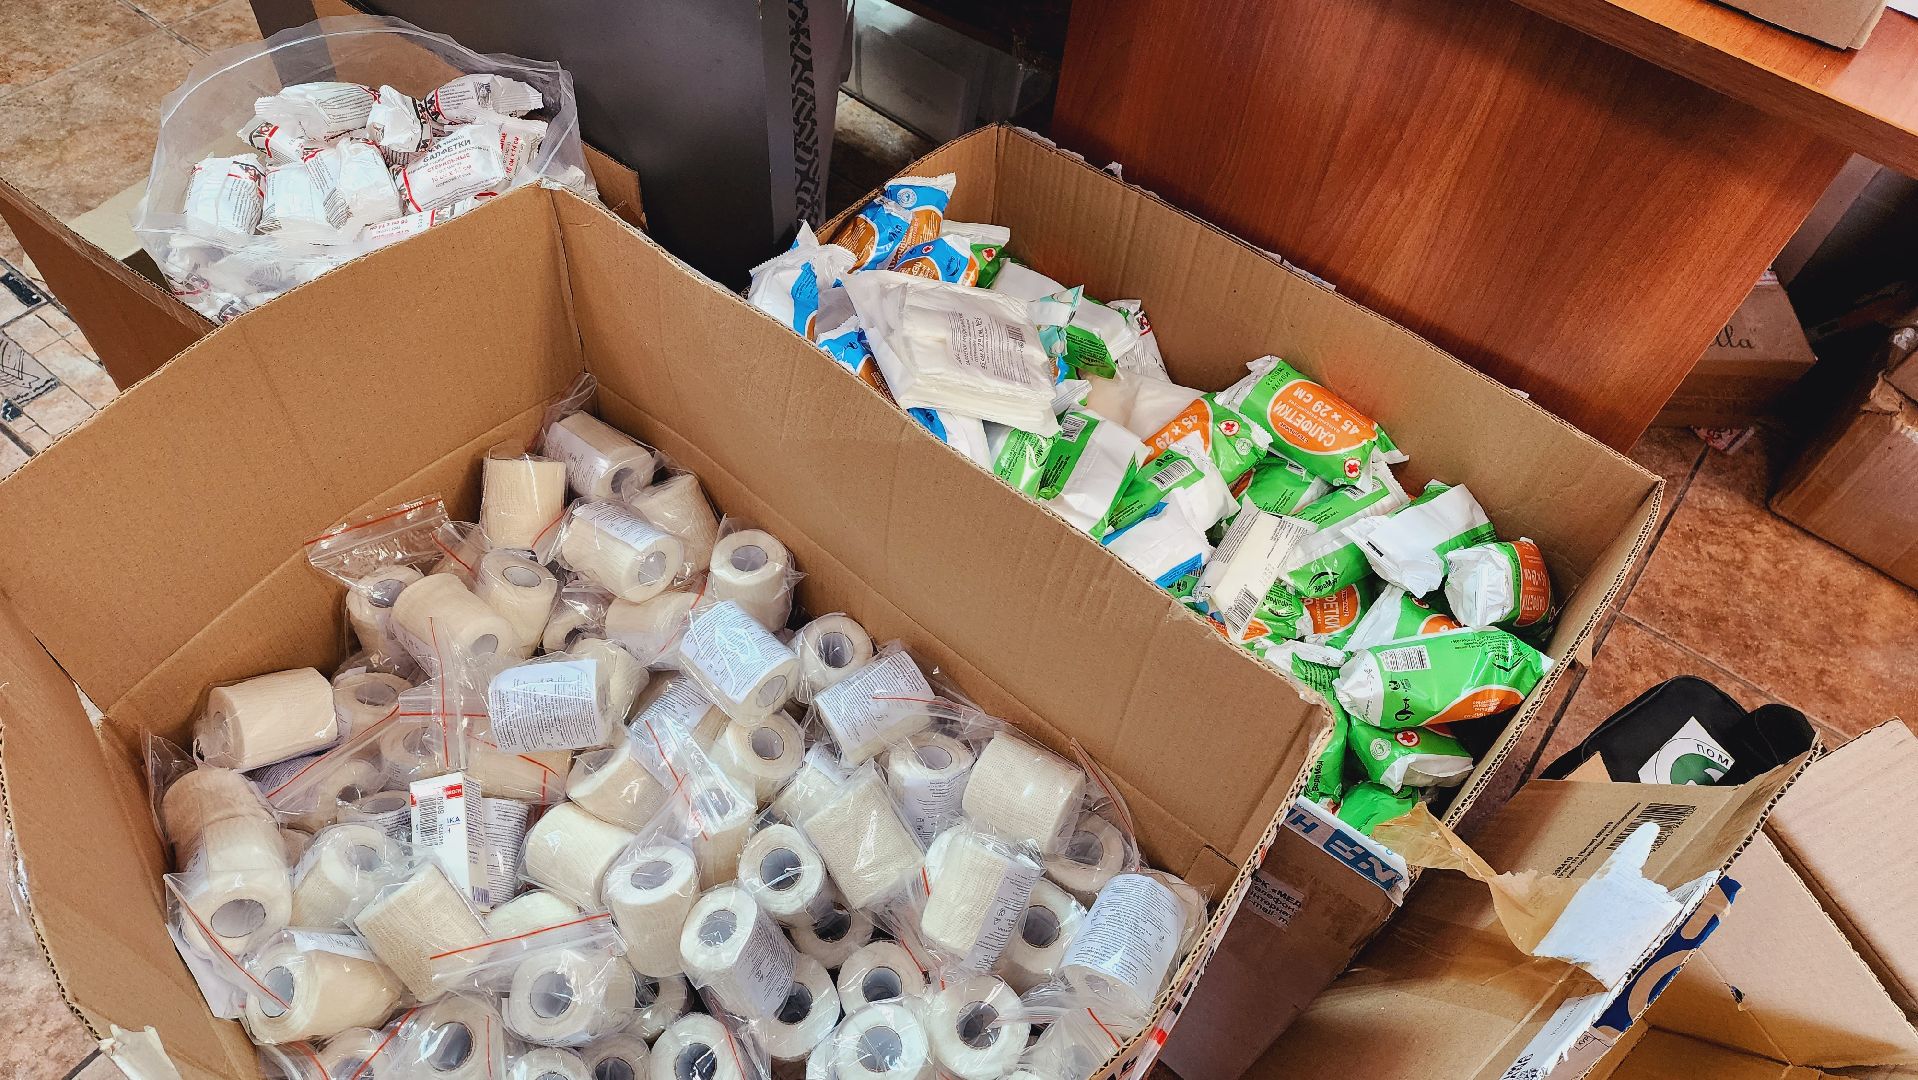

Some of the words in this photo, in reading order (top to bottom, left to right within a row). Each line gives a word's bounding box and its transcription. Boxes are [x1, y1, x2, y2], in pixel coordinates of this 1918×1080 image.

[423, 139, 471, 163] САЛФЕТКИ
[1311, 400, 1333, 418] 29
[1181, 414, 1198, 430] 45
[1273, 400, 1336, 447] САЛФЕТКИ
[1341, 420, 1360, 435] 45
[1324, 595, 1341, 630] ФЕТКИ
[1249, 897, 1276, 918] -mail:
[1254, 885, 1298, 913] елефон:
